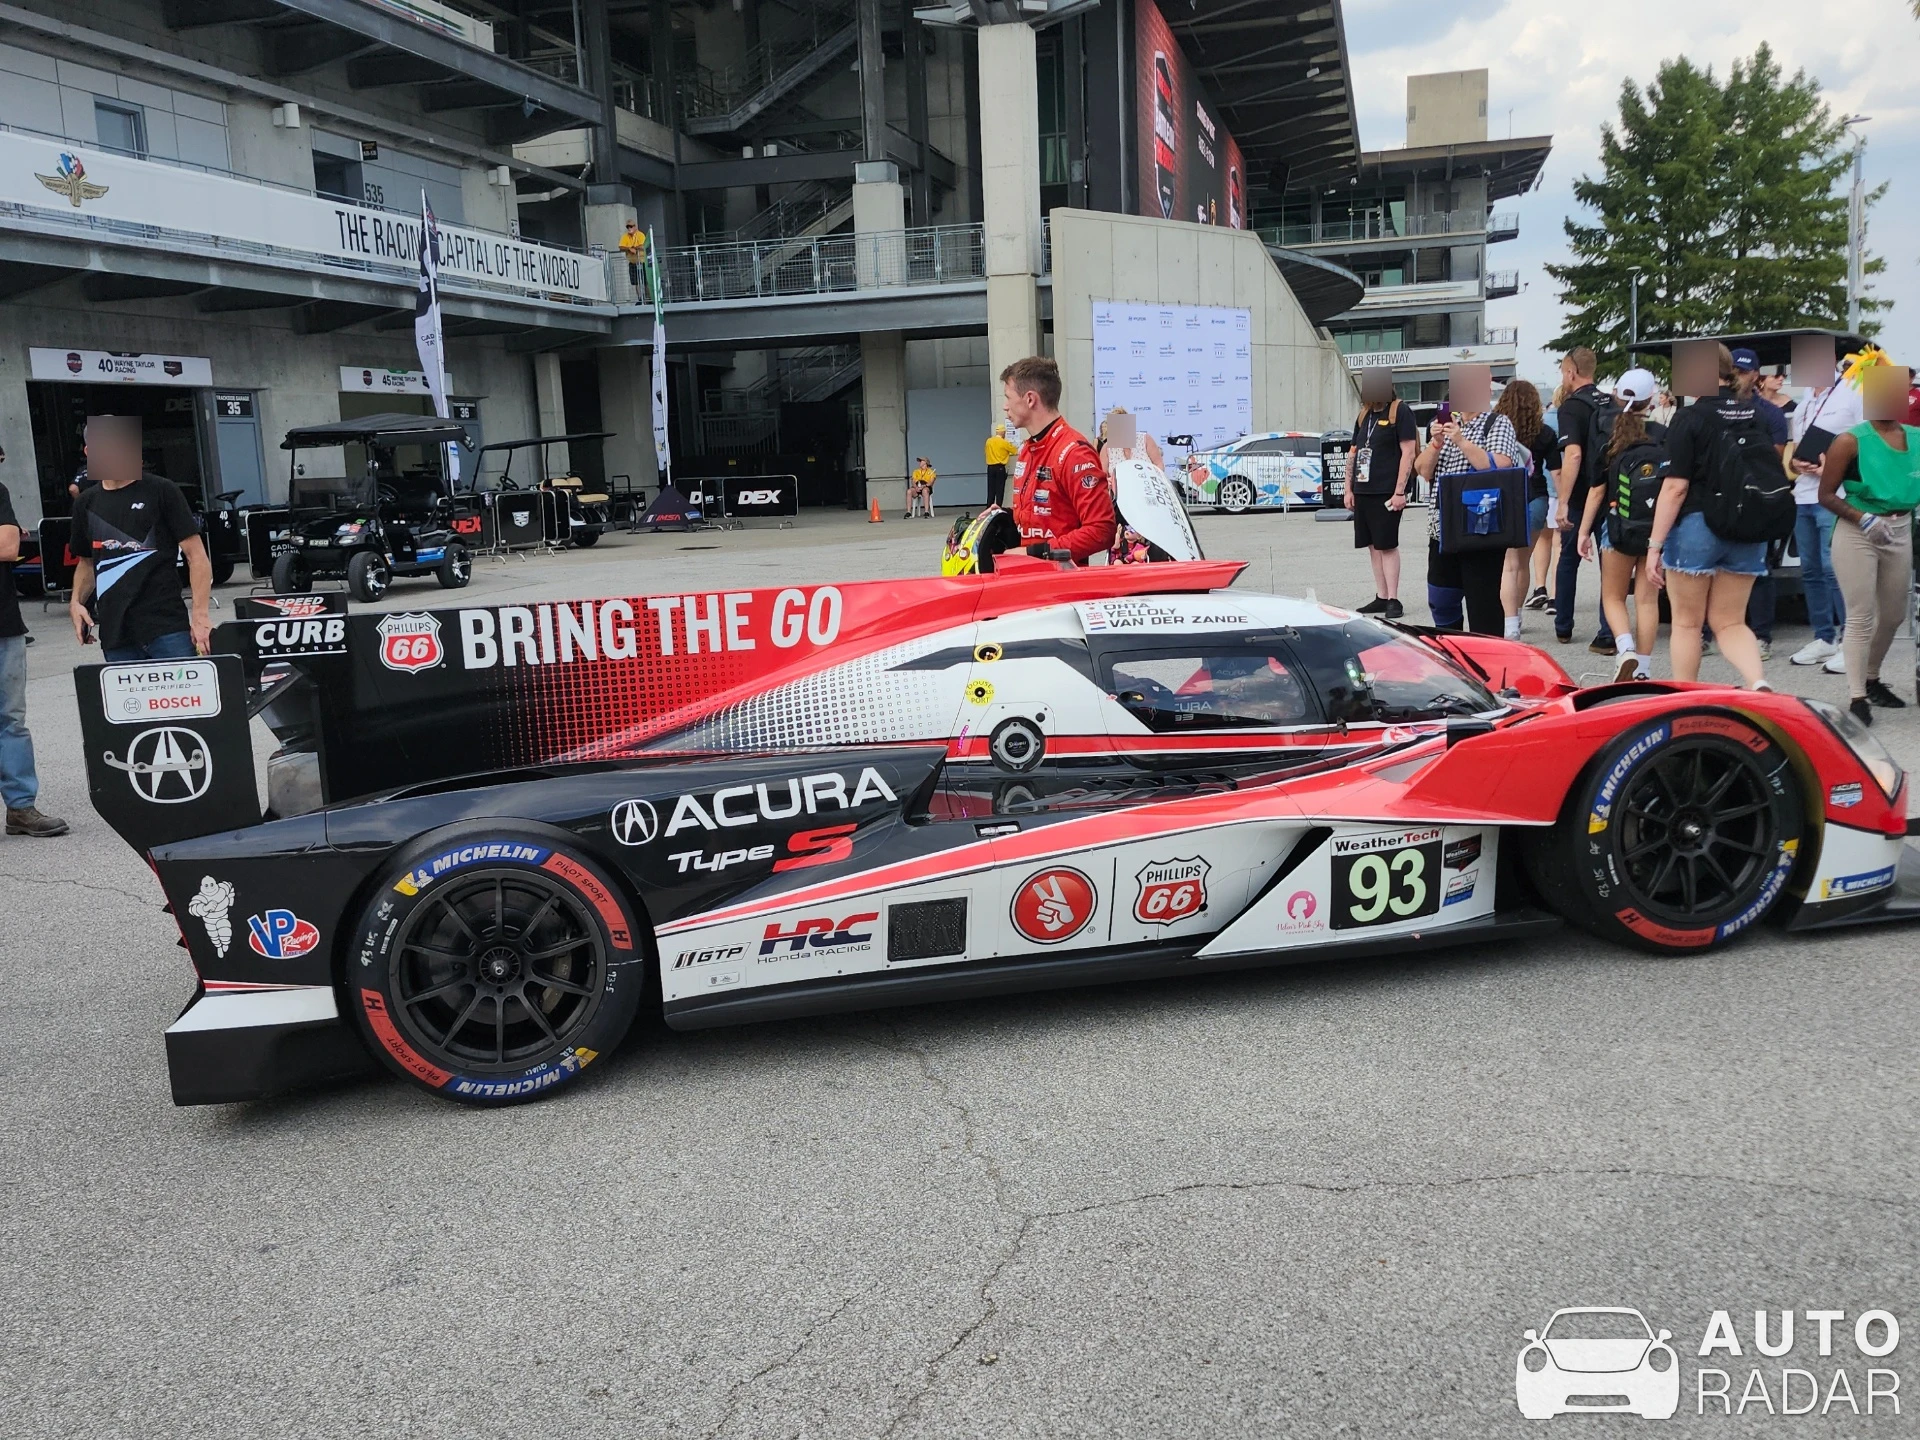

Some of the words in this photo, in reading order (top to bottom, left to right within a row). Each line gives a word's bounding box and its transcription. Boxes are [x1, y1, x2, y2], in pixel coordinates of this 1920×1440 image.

[365, 182, 384, 204] 535
[335, 210, 368, 252] THE
[373, 218, 422, 263] RACIN
[437, 230, 493, 275] CAPITAL
[495, 243, 511, 277] OF
[513, 247, 537, 282] THE
[539, 251, 579, 290] WORLD
[98, 358, 114, 372] 40
[1366, 352, 1410, 366] SPEEDWAY
[382, 375, 392, 386] 45
[227, 401, 241, 415] 35
[460, 408, 470, 418] 36
[1324, 452, 1344, 460] DRIVING
[738, 489, 782, 505] DEX
[219, 510, 228, 520] 40
[656, 513, 681, 522] IMSA
[275, 596, 324, 607] SPEED
[280, 605, 320, 616] SEAT
[1103, 602, 1150, 610] OHTA
[1106, 608, 1177, 618] YELLOLY
[1109, 617, 1144, 628] VAN
[1151, 615, 1184, 625] DER
[1192, 615, 1248, 624] ZANDE
[255, 619, 345, 647] CURB
[387, 620, 432, 634] PHILLIPS
[461, 600, 636, 669] BRING
[646, 592, 755, 656] THE
[771, 586, 842, 648] GO
[258, 644, 346, 655] RECORDS
[391, 637, 429, 660] 66
[118, 667, 199, 685] HYBRID
[967, 680, 993, 690] DOUSE
[129, 683, 192, 693] ELECTRIFIED
[149, 696, 201, 710] BOSCH
[1602, 728, 1663, 800] MICHELIN
[664, 767, 898, 838] ACURA
[667, 844, 775, 873] Type
[772, 823, 858, 873] S
[1335, 828, 1440, 852] WeatherTech
[433, 844, 540, 874] MICHELIN
[555, 860, 581, 880] PILOT
[582, 877, 608, 904] SPORT
[1146, 864, 1202, 883] PHILLIPS
[1845, 872, 1892, 891] MICHELIN
[1349, 848, 1427, 922] 93
[1146, 885, 1194, 914] 66
[1723, 869, 1786, 937] MICHELIN
[246, 908, 297, 957] VP
[282, 931, 317, 951] Racing
[611, 930, 628, 943] H
[758, 911, 880, 956] HRC
[697, 946, 744, 963] GTP
[757, 951, 811, 965] Honda
[814, 943, 871, 957] RACING
[364, 996, 383, 1011] H
[387, 1037, 413, 1063] SPORT
[412, 1060, 441, 1081] PILOT
[456, 1068, 561, 1096] MICHELIN
